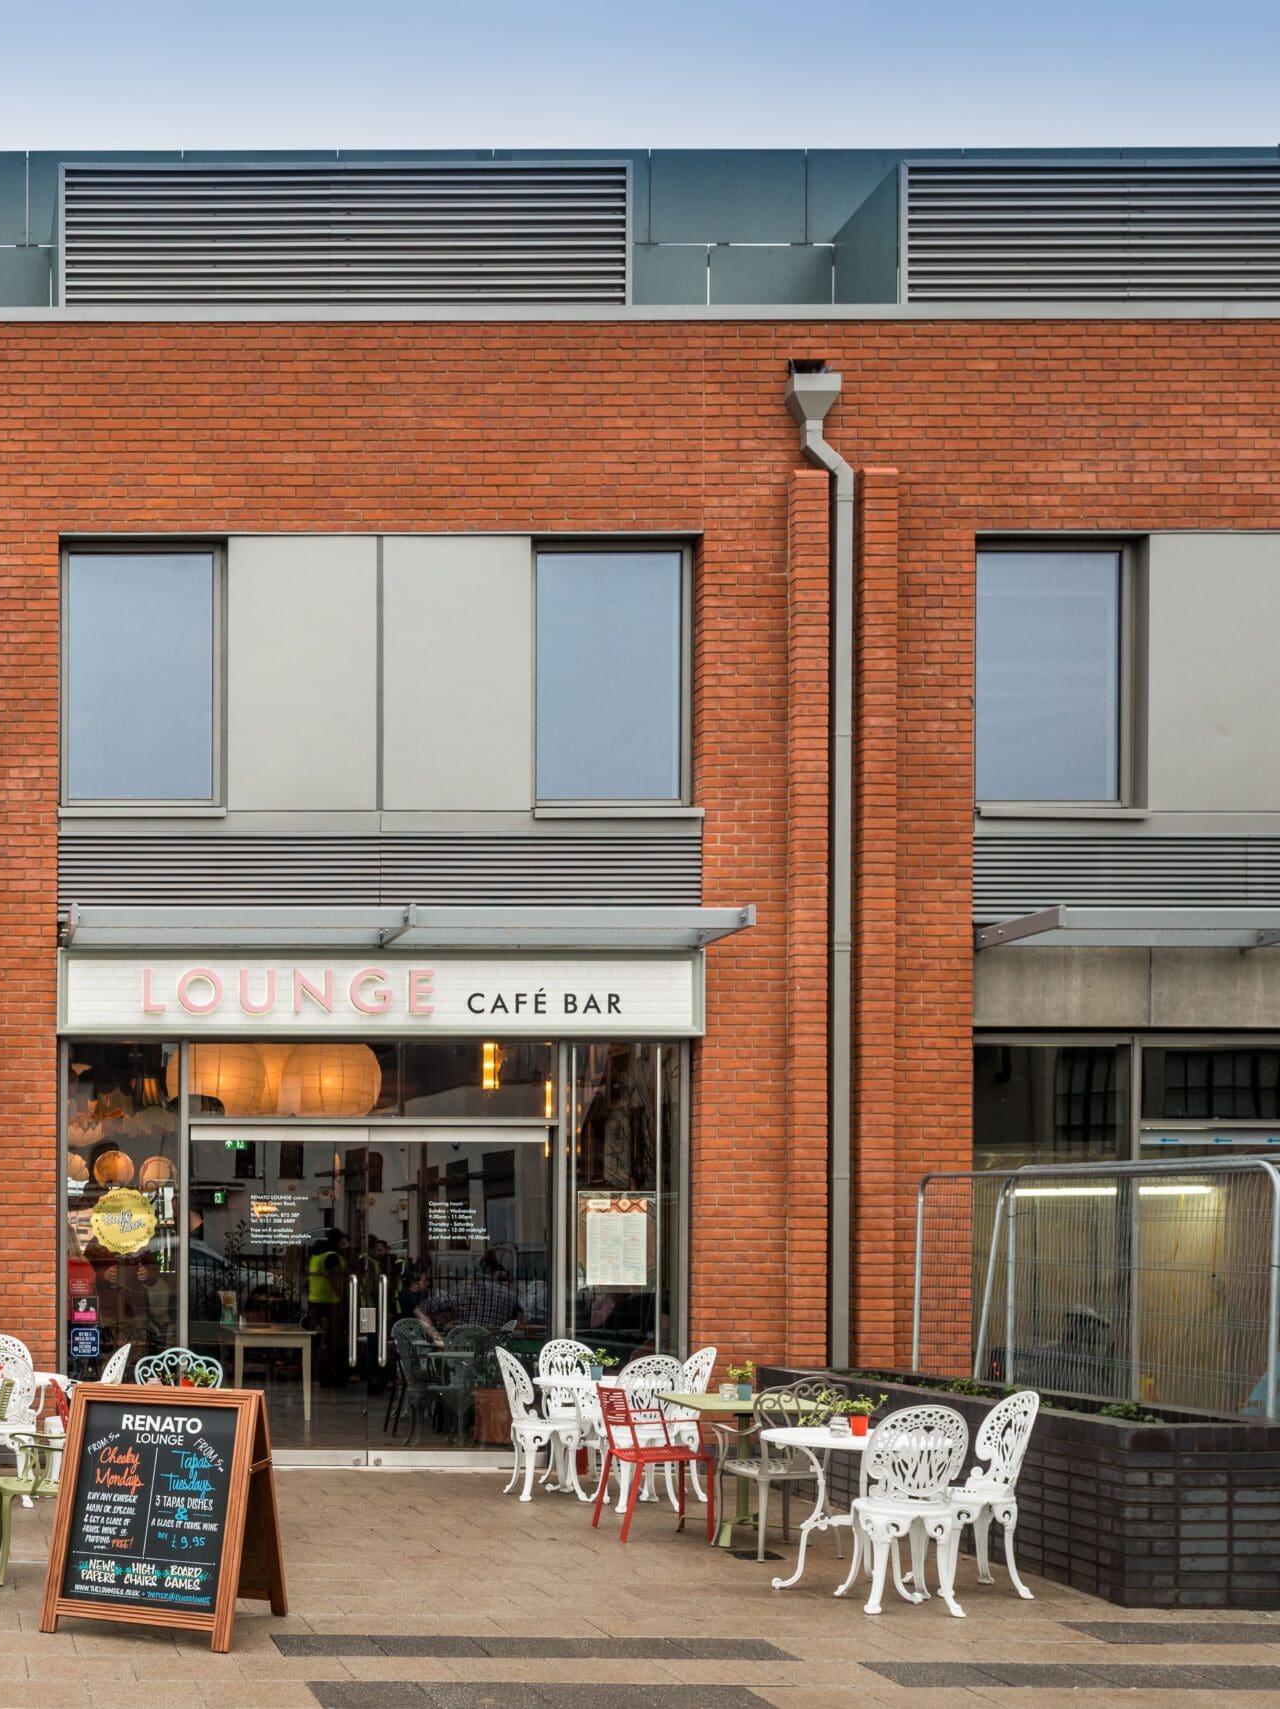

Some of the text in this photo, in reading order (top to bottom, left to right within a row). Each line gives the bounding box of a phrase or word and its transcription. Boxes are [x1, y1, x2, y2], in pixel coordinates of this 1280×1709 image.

[142, 967, 436, 1015] LOUNGE
[467, 988, 622, 1015] CAFÉ BAR
[101, 1209, 133, 1226] Café
[122, 1414, 203, 1434] RENATO
[88, 1438, 112, 1455] FROM
[136, 1433, 184, 1446] LOUNGE
[193, 1438, 218, 1463] FROM
[100, 1447, 141, 1474] Cheeky
[172, 1450, 214, 1479] Tapas
[96, 1467, 145, 1495] Mondays
[160, 1471, 217, 1500] Tuesdays
[100, 1493, 113, 1501] ANY
[155, 1495, 214, 1511] 3 TAPAS DISHES
[112, 1506, 136, 1515] SPECIAL
[175, 1507, 189, 1521] &
[150, 1518, 156, 1527] A
[202, 1522, 220, 1532] WINE
[112, 1537, 134, 1549] FREE!
[89, 1559, 116, 1573] NEWS
[132, 1563, 156, 1575] HIGH
[170, 1564, 203, 1578] BOARD
[81, 1569, 116, 1583] PAPERS
[124, 1573, 158, 1587] CHAIRS
[164, 1576, 201, 1590] GAMES
